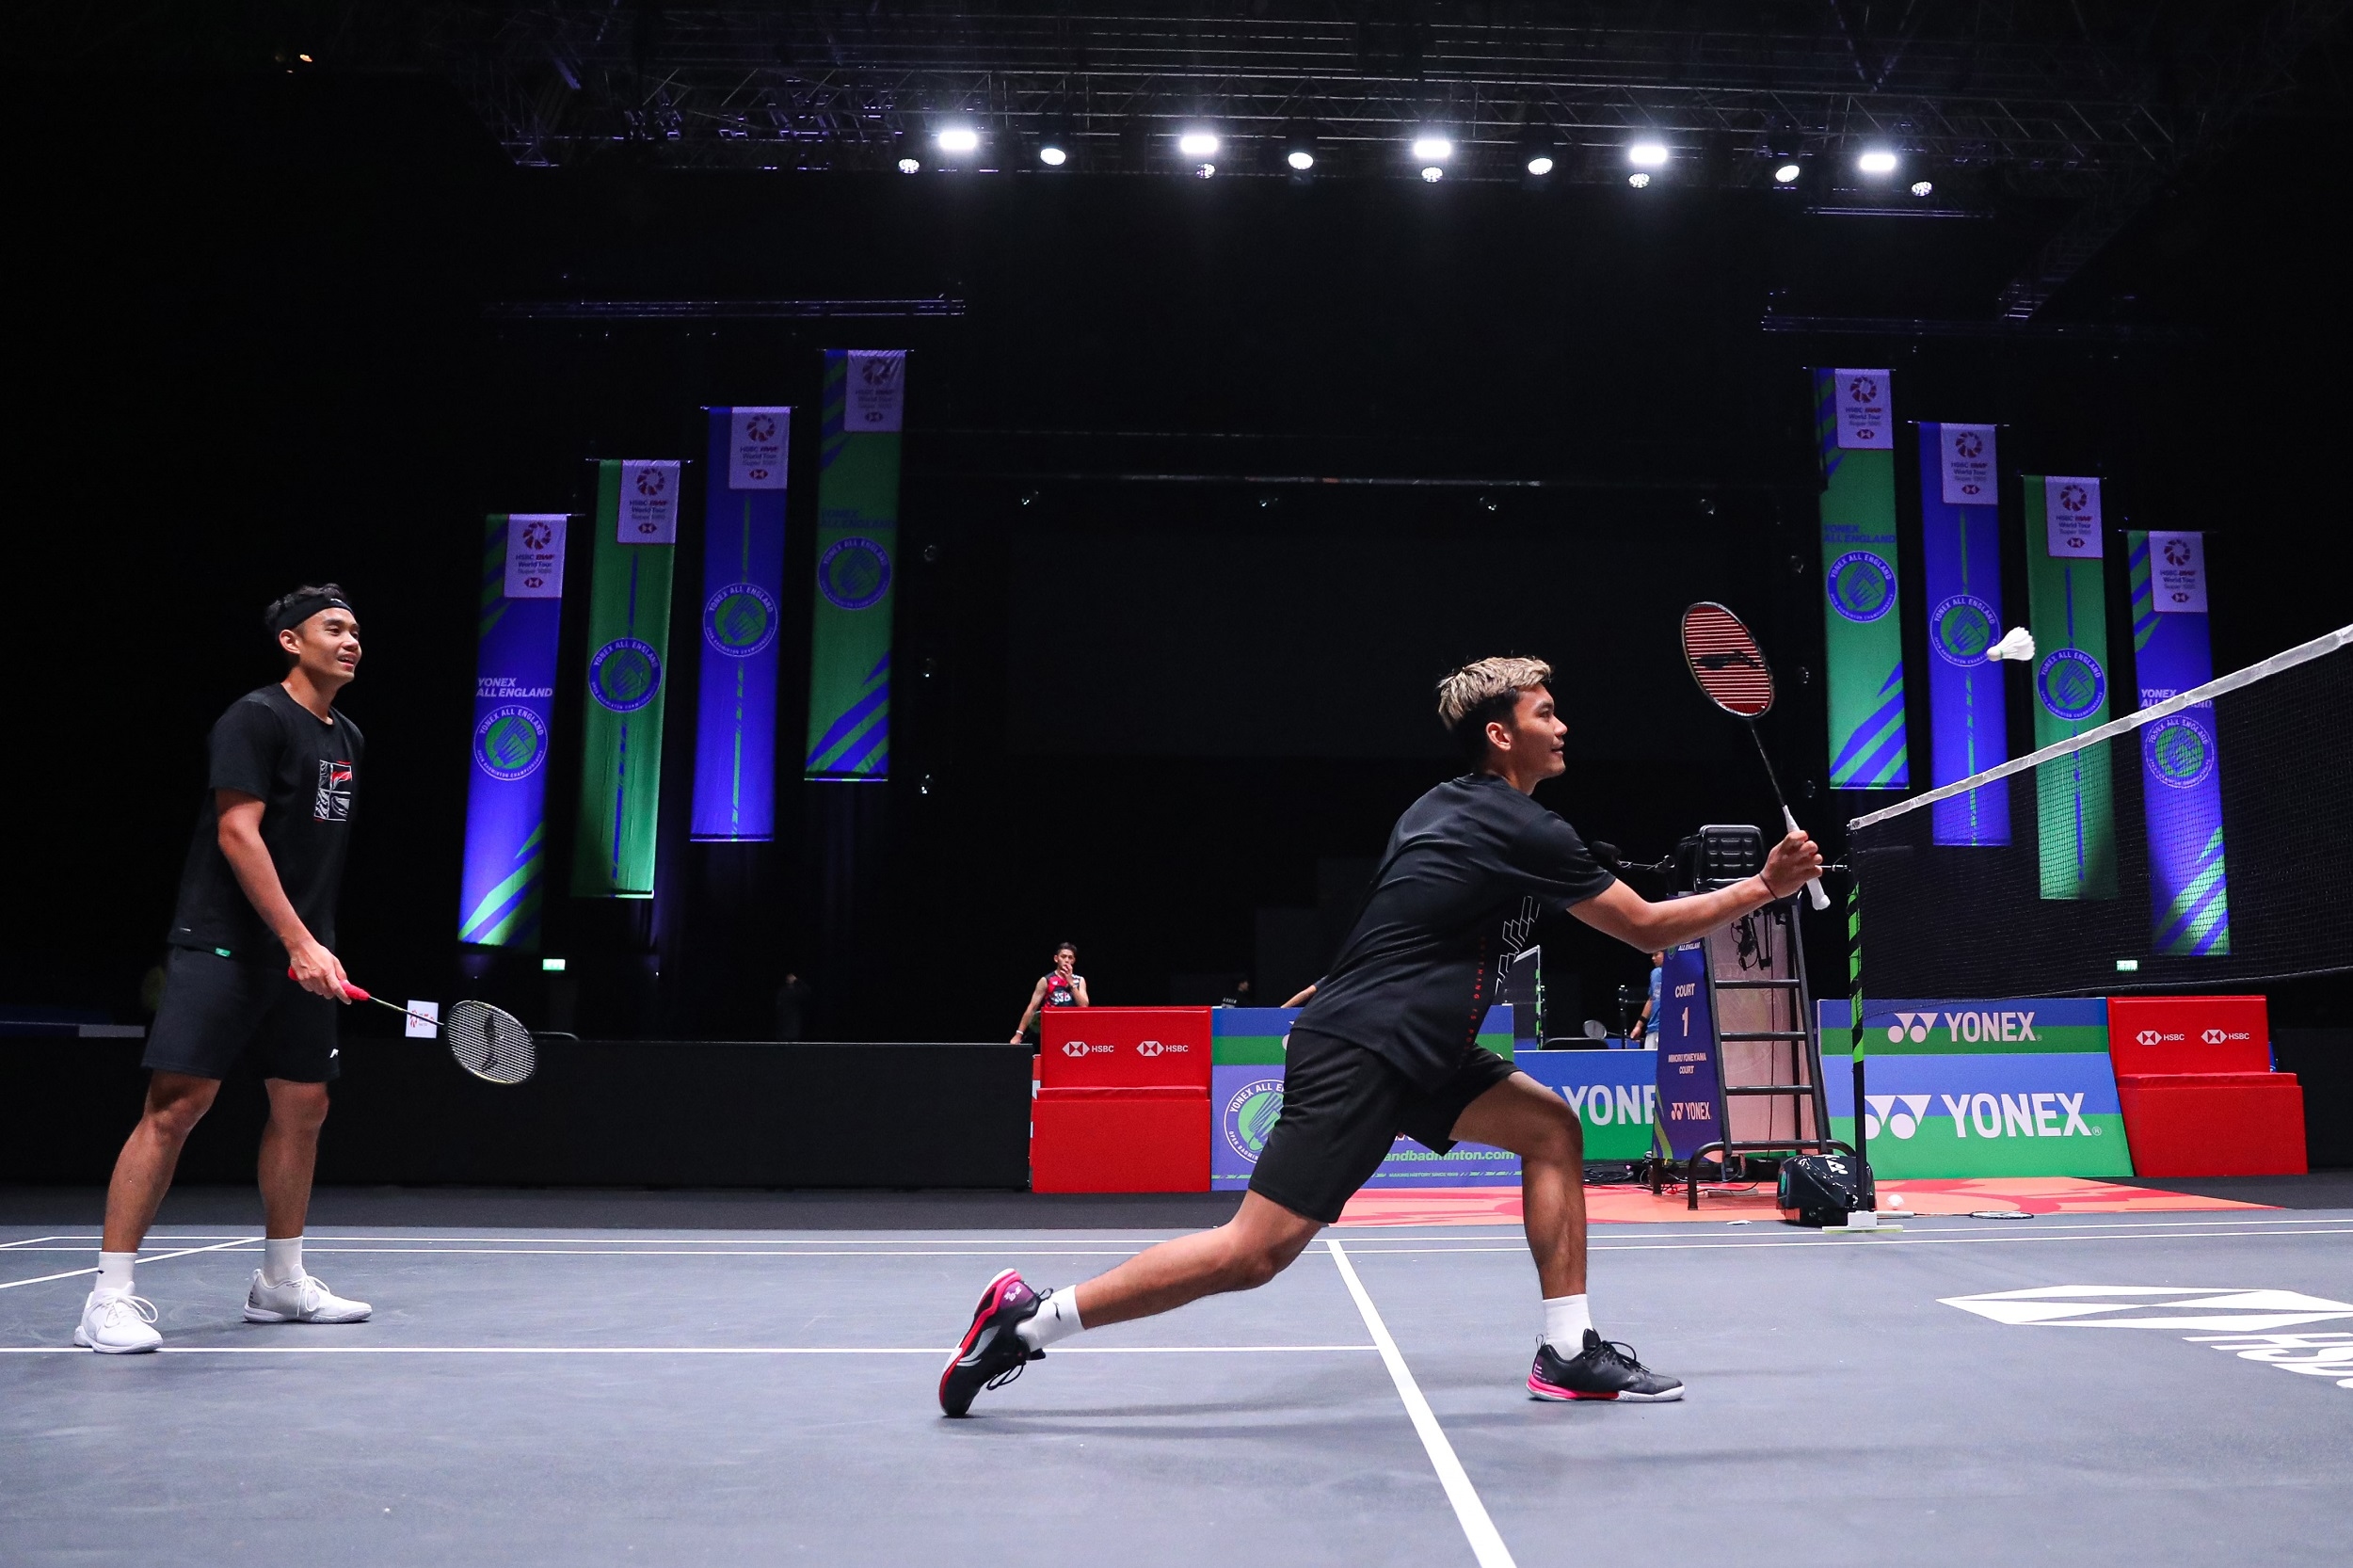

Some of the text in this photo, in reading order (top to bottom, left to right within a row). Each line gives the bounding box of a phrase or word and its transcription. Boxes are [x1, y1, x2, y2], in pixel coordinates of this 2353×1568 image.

[1824, 524, 1859, 533] YONEX
[1824, 535, 1896, 543] ALL ENGLAND
[1832, 553, 1893, 580] YONEX ALL ENGLAND
[710, 590, 728, 612] YONEX
[1935, 598, 1996, 624] YONEX ALL ENGLAND
[595, 645, 614, 666] YONEX
[614, 641, 630, 649] ALL
[2042, 651, 2102, 678] YONEX ALL ENGLAND
[476, 688, 553, 696] ALL ENGLAND
[478, 678, 517, 687] YONEX
[2141, 689, 2176, 698] YONEX
[480, 712, 500, 734] YONEX
[517, 710, 544, 736] ENGLAND
[1675, 983, 1695, 998] COURT
[1682, 1007, 1689, 1036] 1
[1945, 1012, 2037, 1043] YONEX
[1679, 1065, 1694, 1074] COURT
[1229, 1088, 1254, 1112] YONEX
[1256, 1083, 1273, 1093] ALL
[1562, 1084, 1656, 1126] YONE
[1685, 1102, 1710, 1120] YONEX
[1941, 1093, 2091, 1138] YONEX
[1229, 1131, 1258, 1160] OPEN BADMIN
